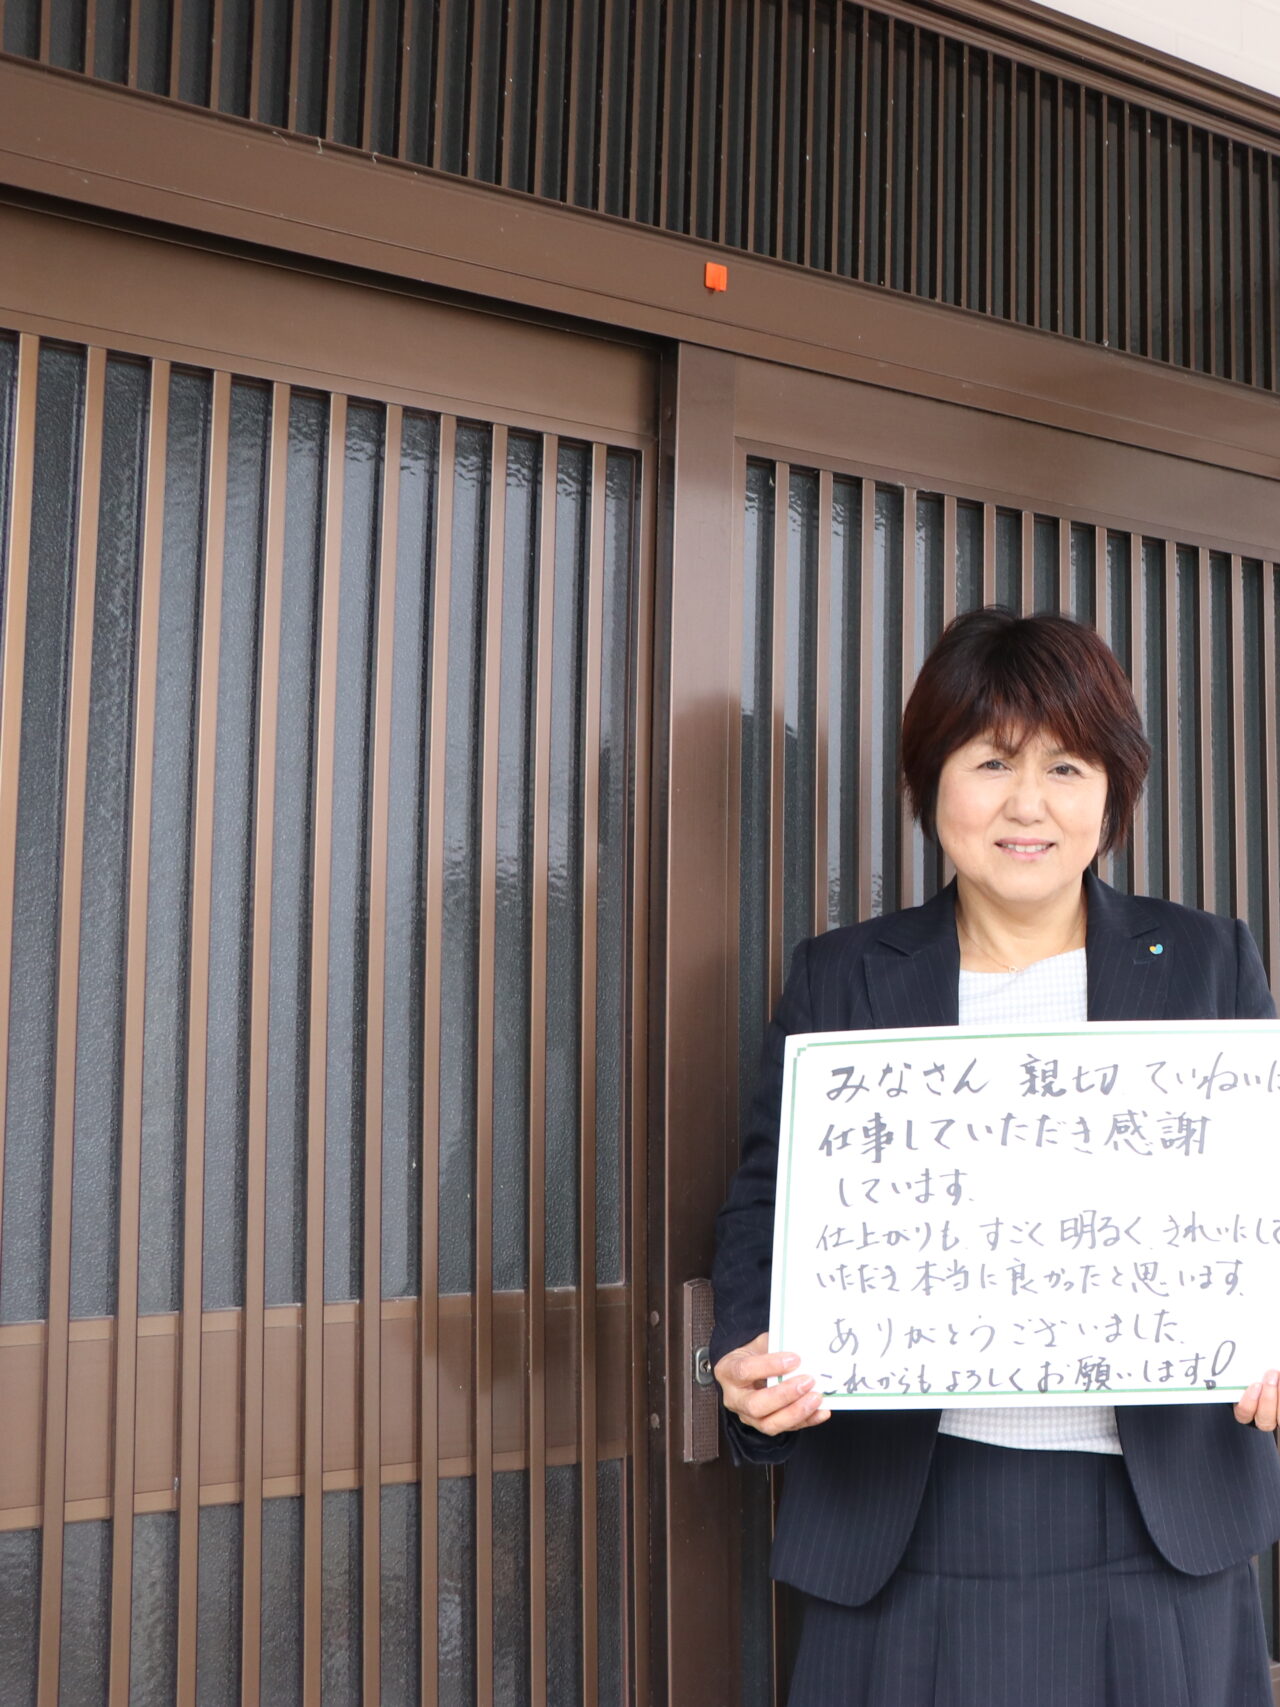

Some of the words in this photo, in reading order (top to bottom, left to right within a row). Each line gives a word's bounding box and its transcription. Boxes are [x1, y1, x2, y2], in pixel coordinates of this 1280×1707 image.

[825, 1057, 990, 1103] みなさん
[1019, 1053, 1118, 1097] 親切
[818, 1109, 1212, 1164] 仕事していただき感謝
